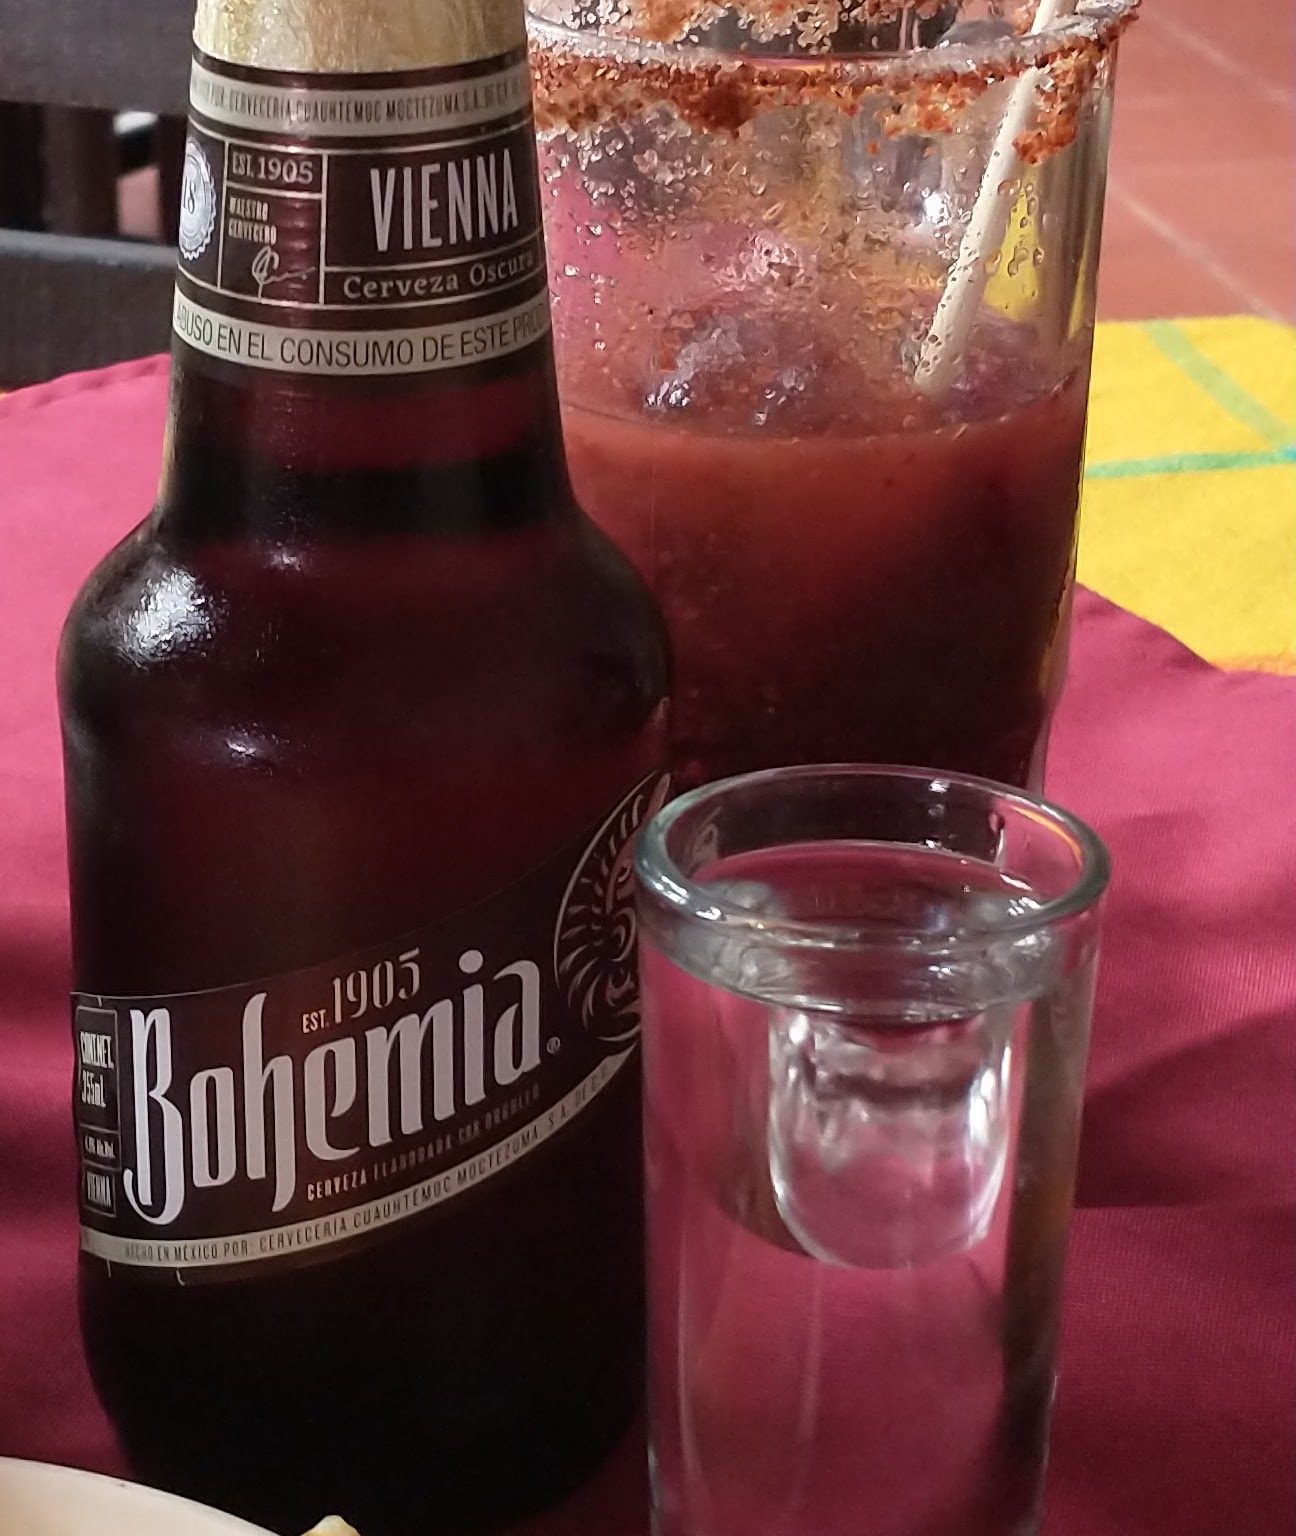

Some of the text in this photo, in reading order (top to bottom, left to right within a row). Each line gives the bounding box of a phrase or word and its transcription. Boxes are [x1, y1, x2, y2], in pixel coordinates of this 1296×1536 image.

[232, 151, 313, 185] EST. 1905
[229, 196, 270, 222] MAESTRO
[370, 147, 519, 252] VIENNA
[228, 217, 278, 246] CERVECERO
[343, 273, 459, 300] Cerveza
[217, 323, 242, 355] EN
[247, 331, 274, 362] EL
[280, 336, 414, 368] CONSUMO
[422, 333, 454, 363] DE
[460, 320, 508, 358] ESTE
[302, 947, 420, 1034] EST. 1905
[124, 949, 542, 1226] Bohemia
[157, 1243, 170, 1262] EN
[174, 1240, 219, 1263] MÉXICO
[259, 1214, 348, 1254] CERVECERÍA
[456, 1123, 540, 1186] MOCTEZUMA
[307, 1167, 367, 1202] CERVEZA
